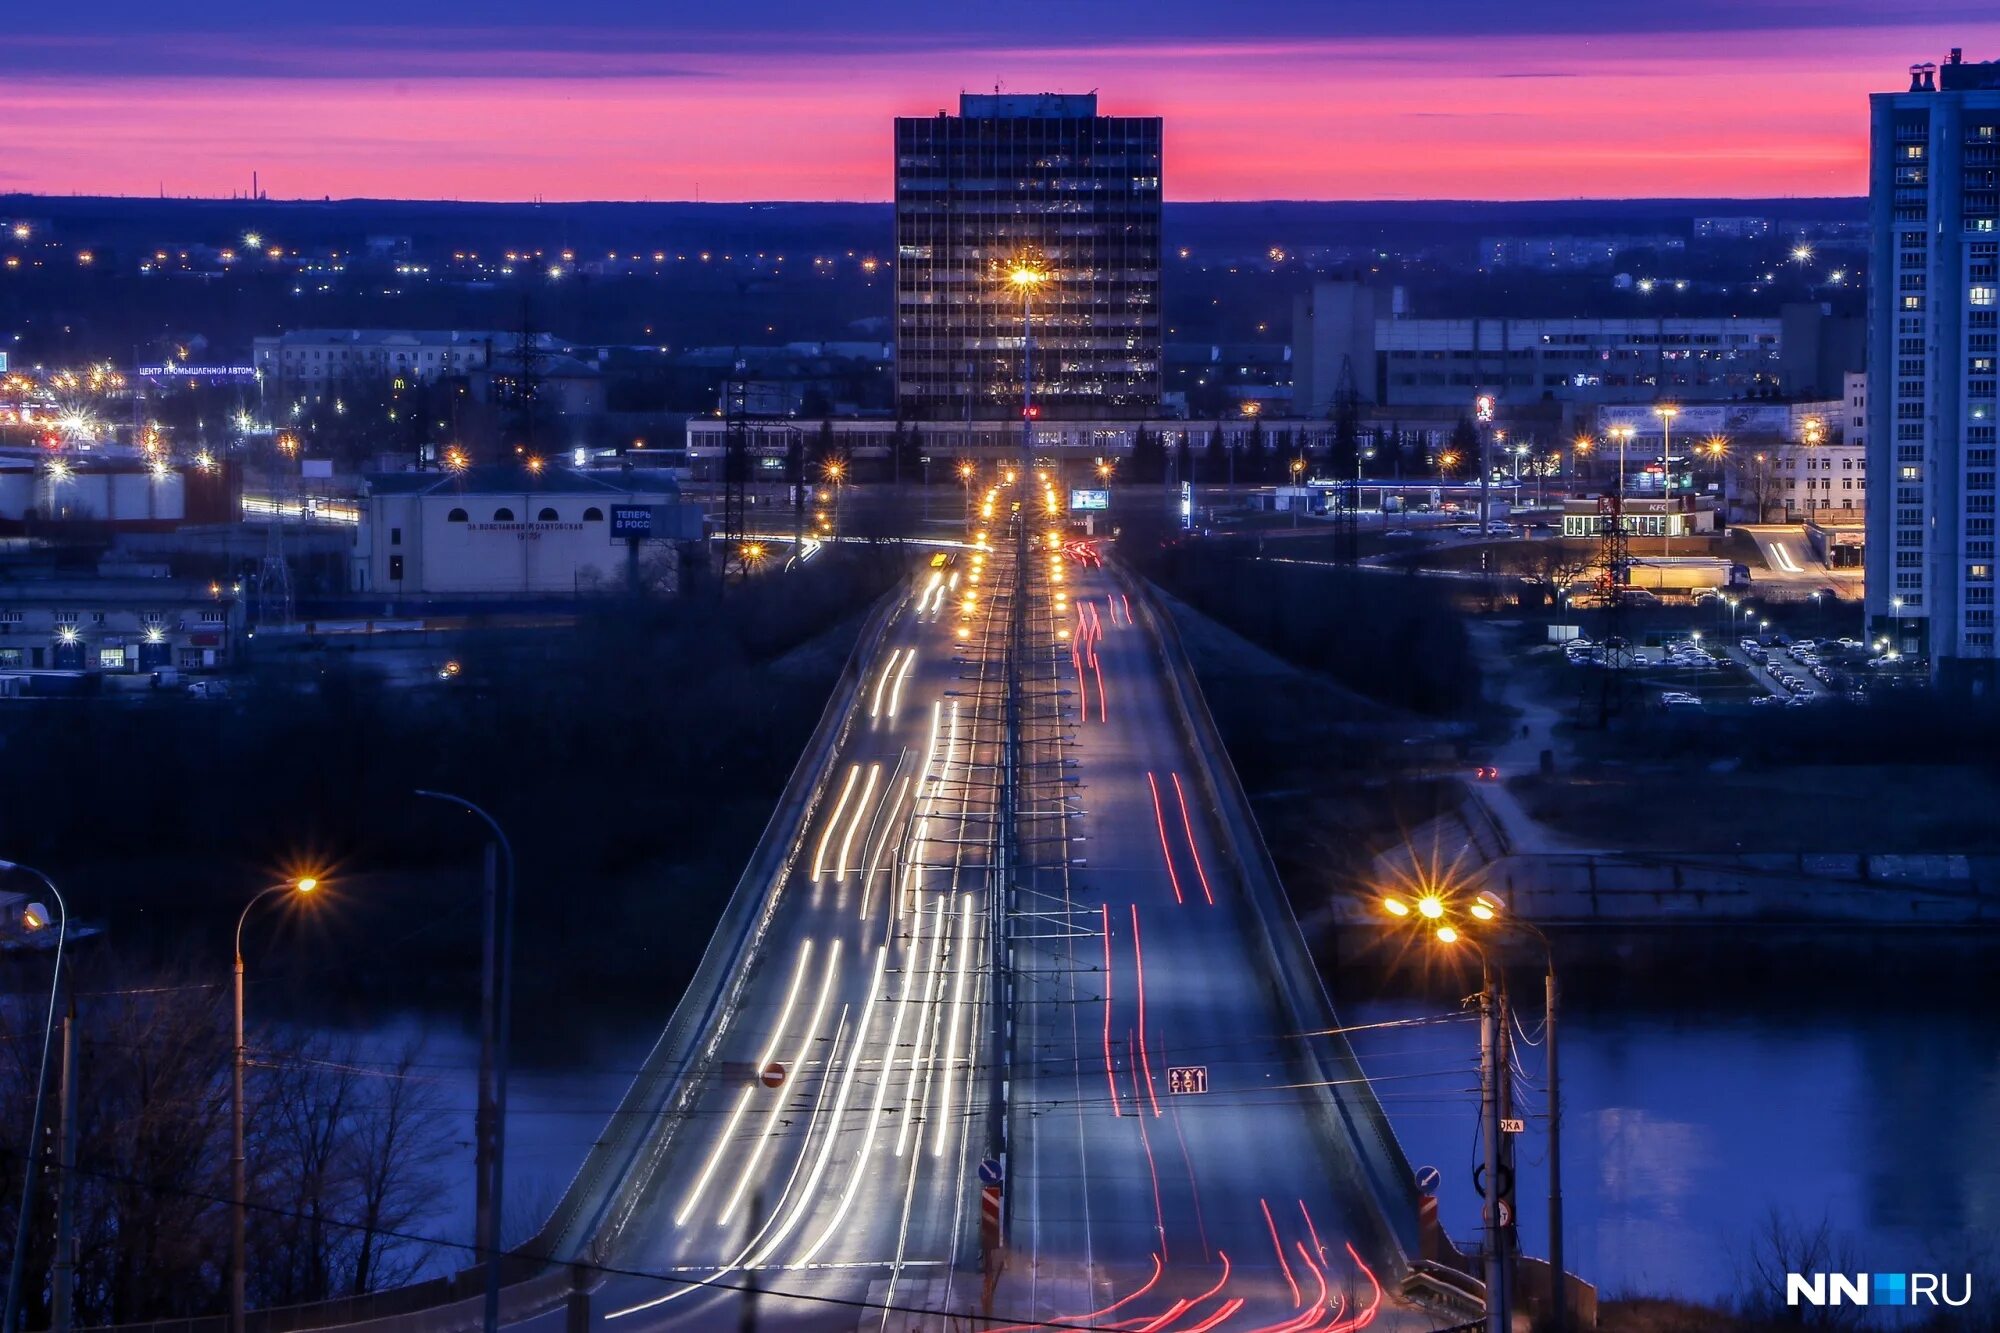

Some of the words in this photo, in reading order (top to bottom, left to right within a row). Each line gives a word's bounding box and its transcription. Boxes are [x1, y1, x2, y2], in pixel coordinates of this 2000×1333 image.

[139, 367, 162, 376] ЦЕНТР
[616, 510, 652, 519] ТЕПЕРЬ
[616, 520, 623, 529] В
[625, 520, 652, 529] РОСС
